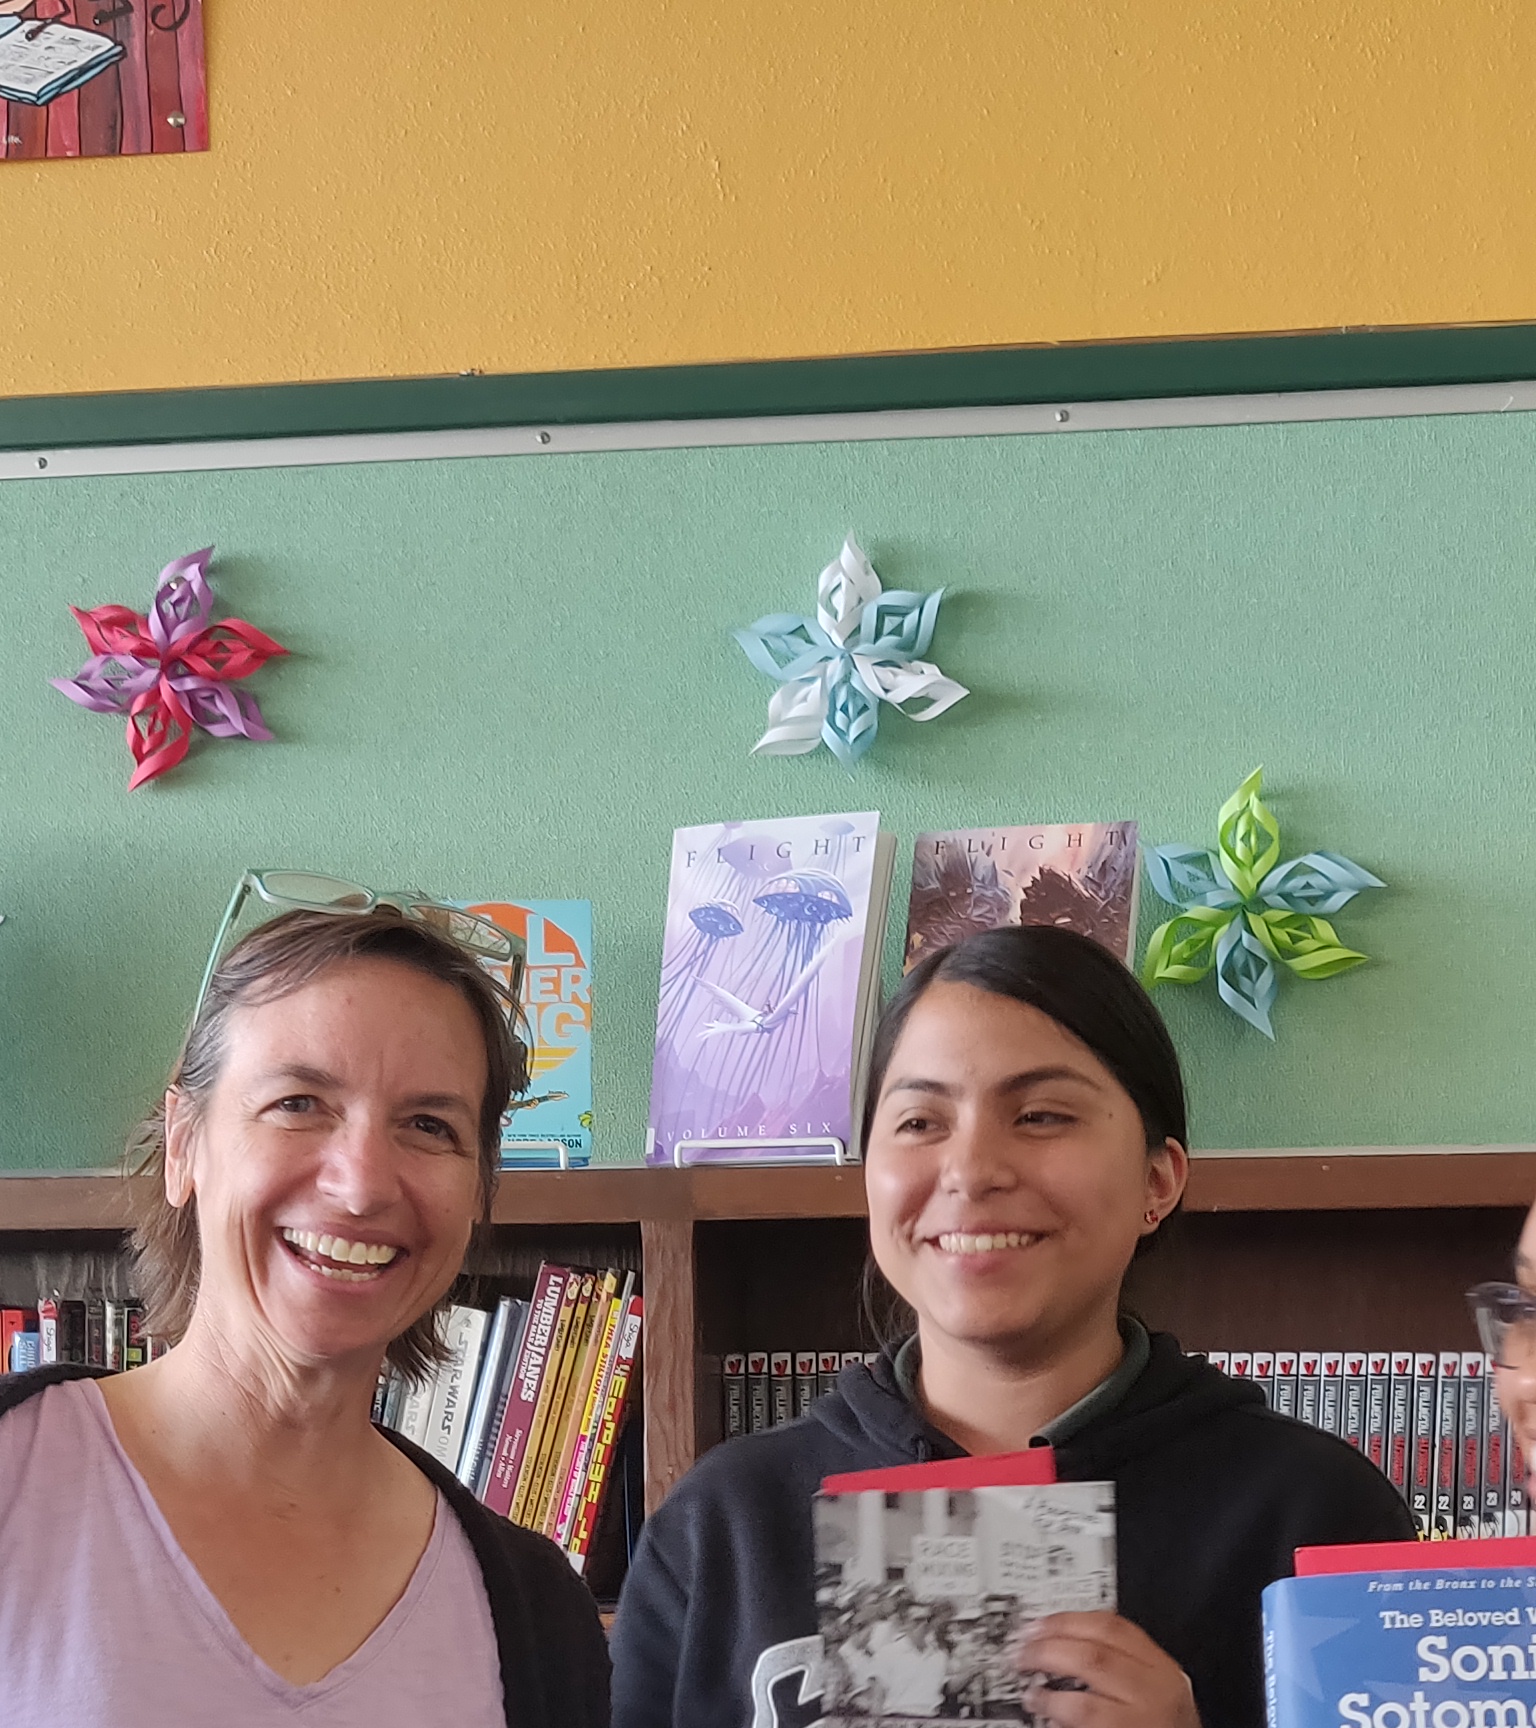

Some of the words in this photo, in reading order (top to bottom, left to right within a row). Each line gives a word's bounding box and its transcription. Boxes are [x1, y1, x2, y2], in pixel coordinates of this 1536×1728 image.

[685, 833, 866, 870] FLIGHT
[934, 829, 1121, 857] FLIGHT
[665, 1123, 768, 1143] VOLUME
[788, 1120, 834, 1137] SIX
[520, 1274, 563, 1402] LUMBERJANES
[604, 1324, 616, 1350] THEA
[625, 1323, 638, 1348] Shiga
[593, 1352, 607, 1396] STILTON
[1414, 1494, 1426, 1510] 22
[1463, 1495, 1474, 1510] 23
[1367, 1580, 1406, 1593] From
[1408, 1579, 1432, 1592] the
[1434, 1579, 1477, 1591] Bronx
[1479, 1579, 1496, 1590] to
[1499, 1577, 1523, 1589] the
[1379, 1610, 1424, 1630] The
[1429, 1607, 1521, 1628] Beloved
